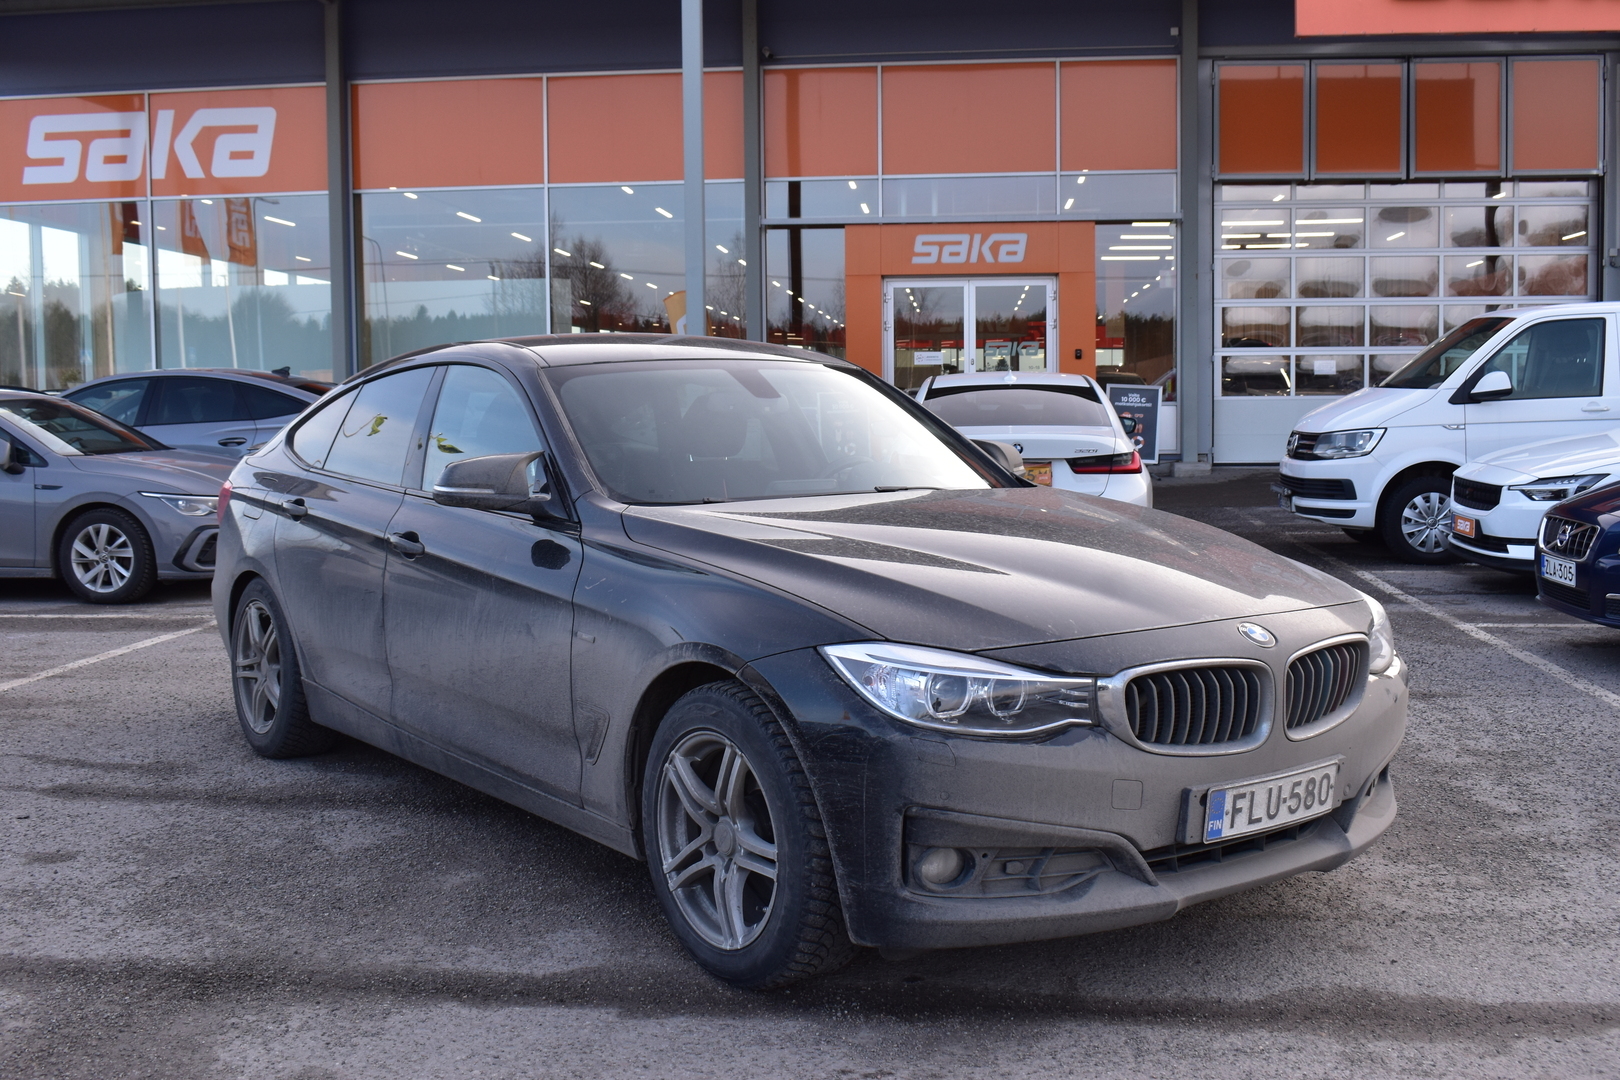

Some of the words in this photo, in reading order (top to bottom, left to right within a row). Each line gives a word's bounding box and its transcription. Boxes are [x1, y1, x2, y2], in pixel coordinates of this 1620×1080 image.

[1545, 559, 1574, 581] ZLA-305
[1229, 772, 1331, 829] FLU-580
[1208, 819, 1223, 831] FIN
